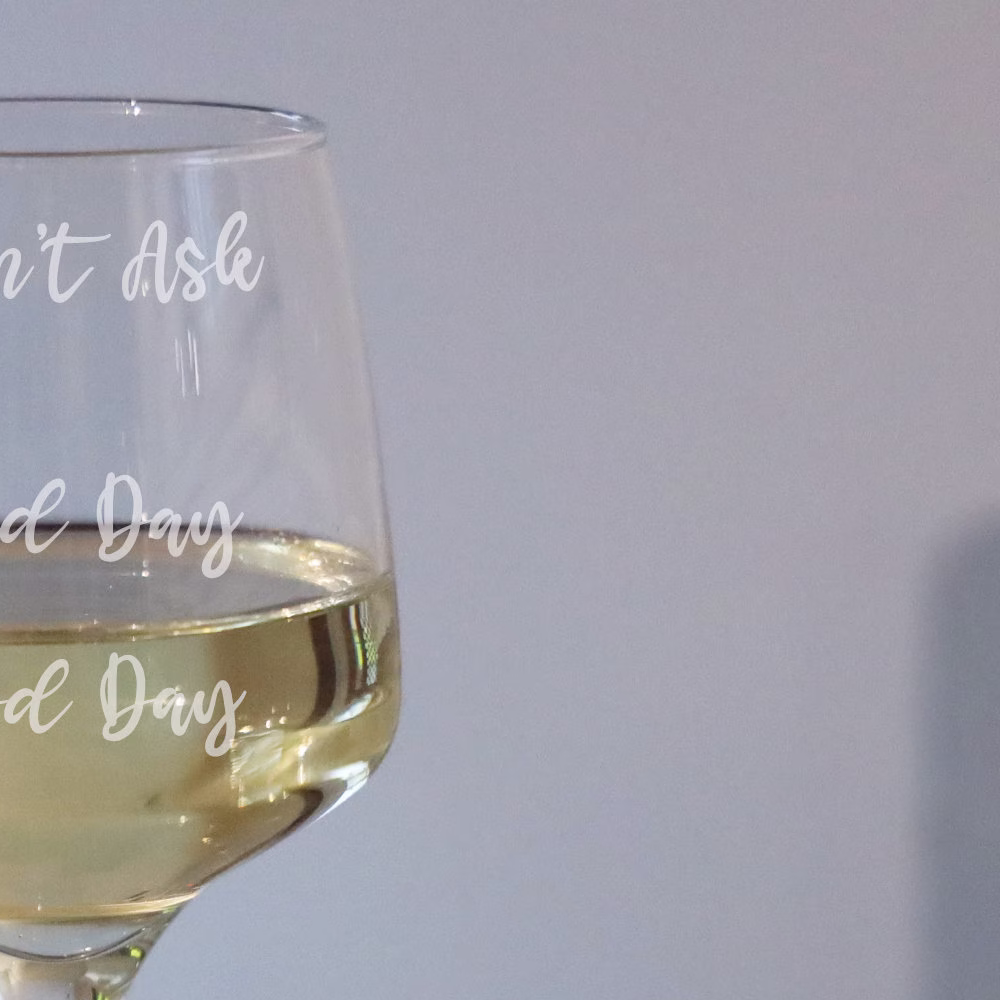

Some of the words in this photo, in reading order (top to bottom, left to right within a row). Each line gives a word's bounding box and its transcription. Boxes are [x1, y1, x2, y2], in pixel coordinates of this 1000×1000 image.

[121, 210, 265, 304] Ask
[96, 471, 245, 579] Day
[100, 651, 248, 757] Day
